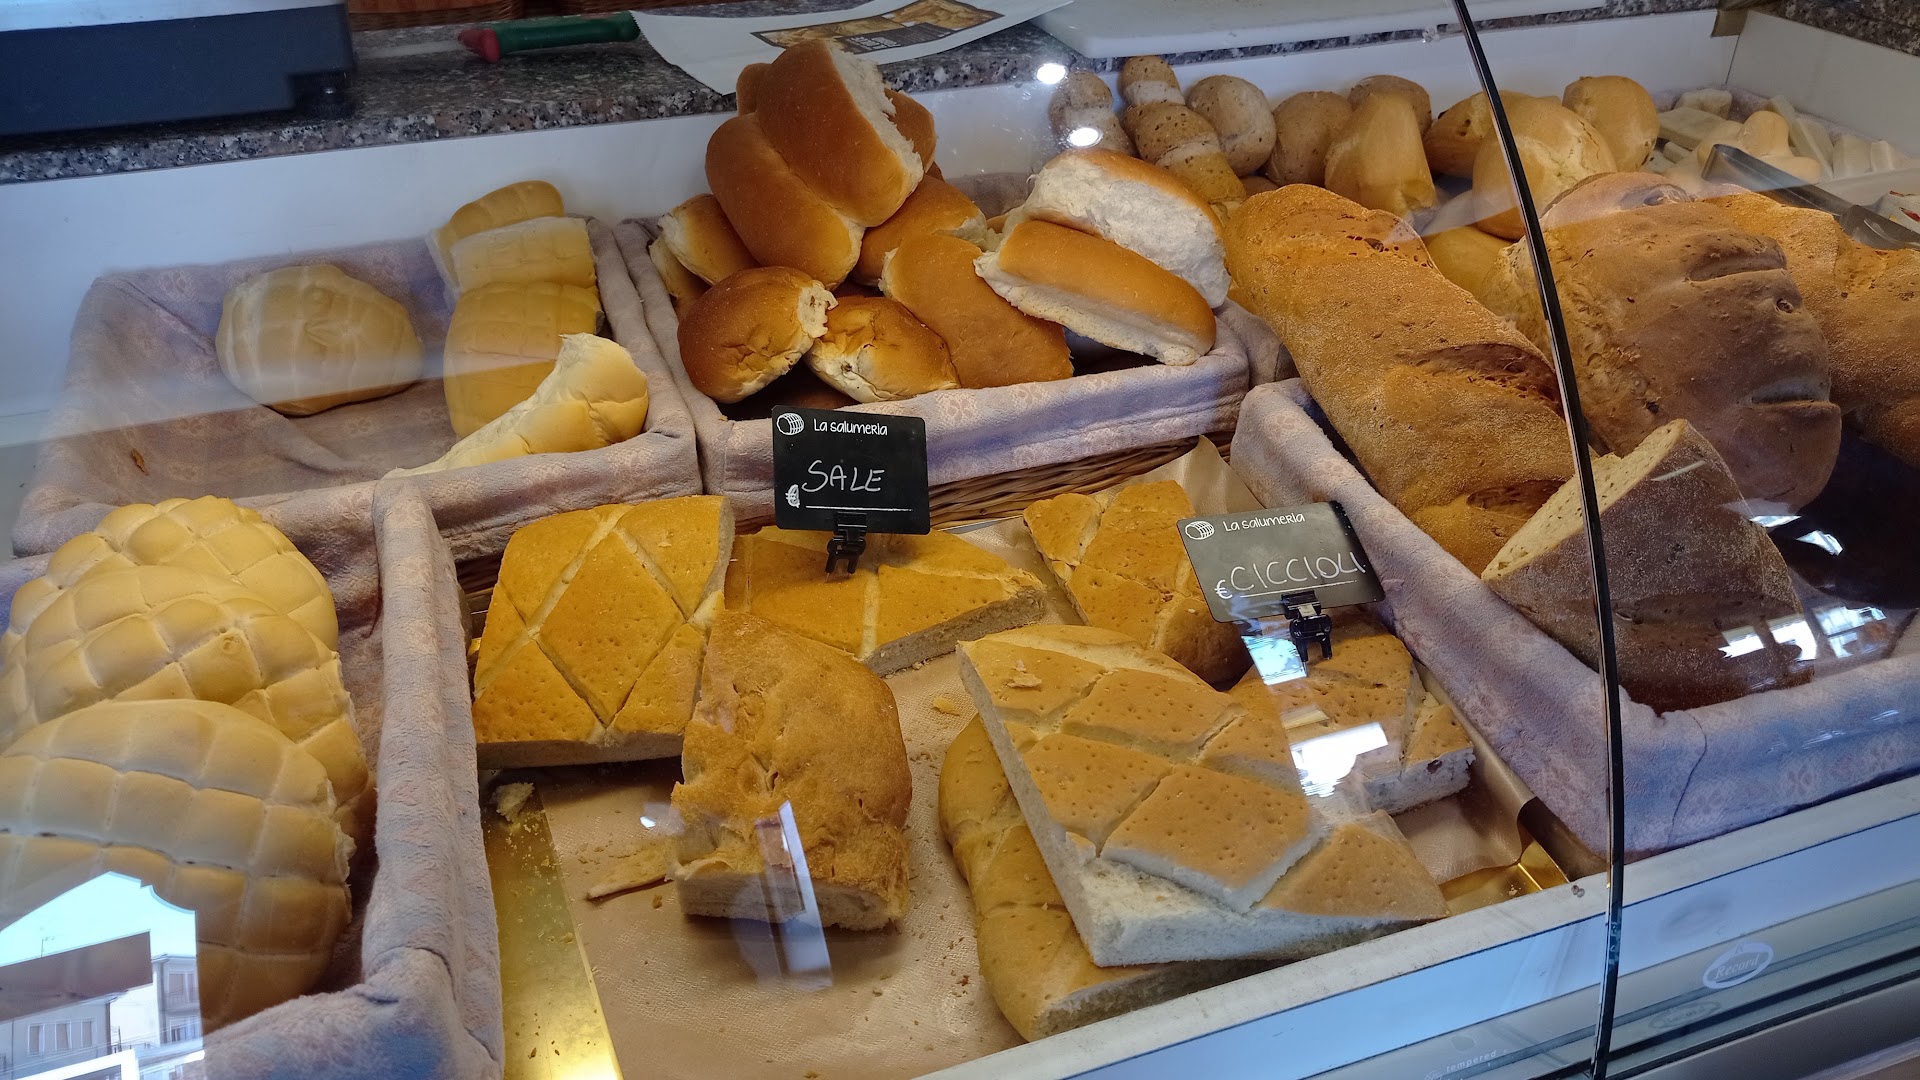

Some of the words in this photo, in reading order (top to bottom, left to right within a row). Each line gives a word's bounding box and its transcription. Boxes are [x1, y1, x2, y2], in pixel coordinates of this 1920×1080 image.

[813, 418, 827, 432] La
[801, 460, 885, 492] SALE
[1223, 520, 1240, 532] La
[1214, 579, 1232, 599] €
[1230, 552, 1366, 591] CICCIOLI
[1713, 953, 1760, 980] Record
[1445, 1050, 1497, 1073] tempered
